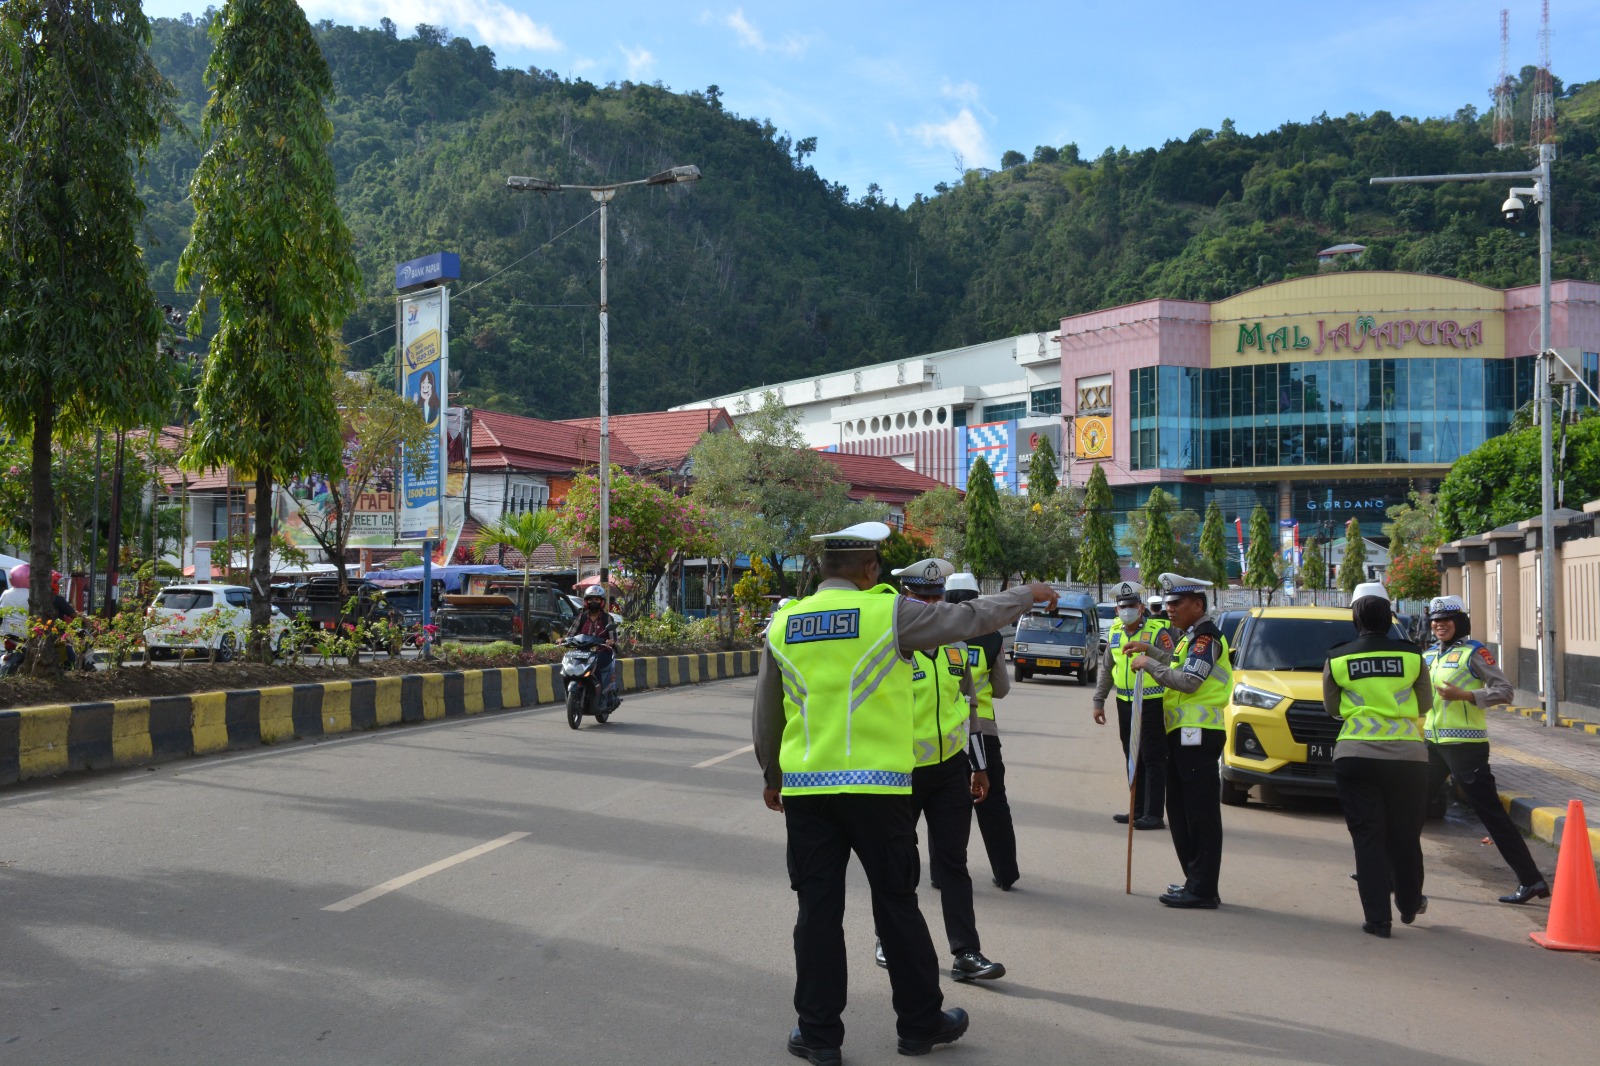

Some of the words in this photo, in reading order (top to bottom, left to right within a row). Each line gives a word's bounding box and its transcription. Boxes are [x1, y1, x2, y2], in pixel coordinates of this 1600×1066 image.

[411, 267, 424, 279] BANK
[425, 262, 440, 274] PAPUA
[1236, 321, 1311, 353] MAL
[1314, 315, 1484, 354] JAYAPURA
[1079, 385, 1112, 410] XXI
[788, 613, 856, 638] POLISI
[1350, 659, 1403, 676] POLISI
[1311, 745, 1323, 757] PA
